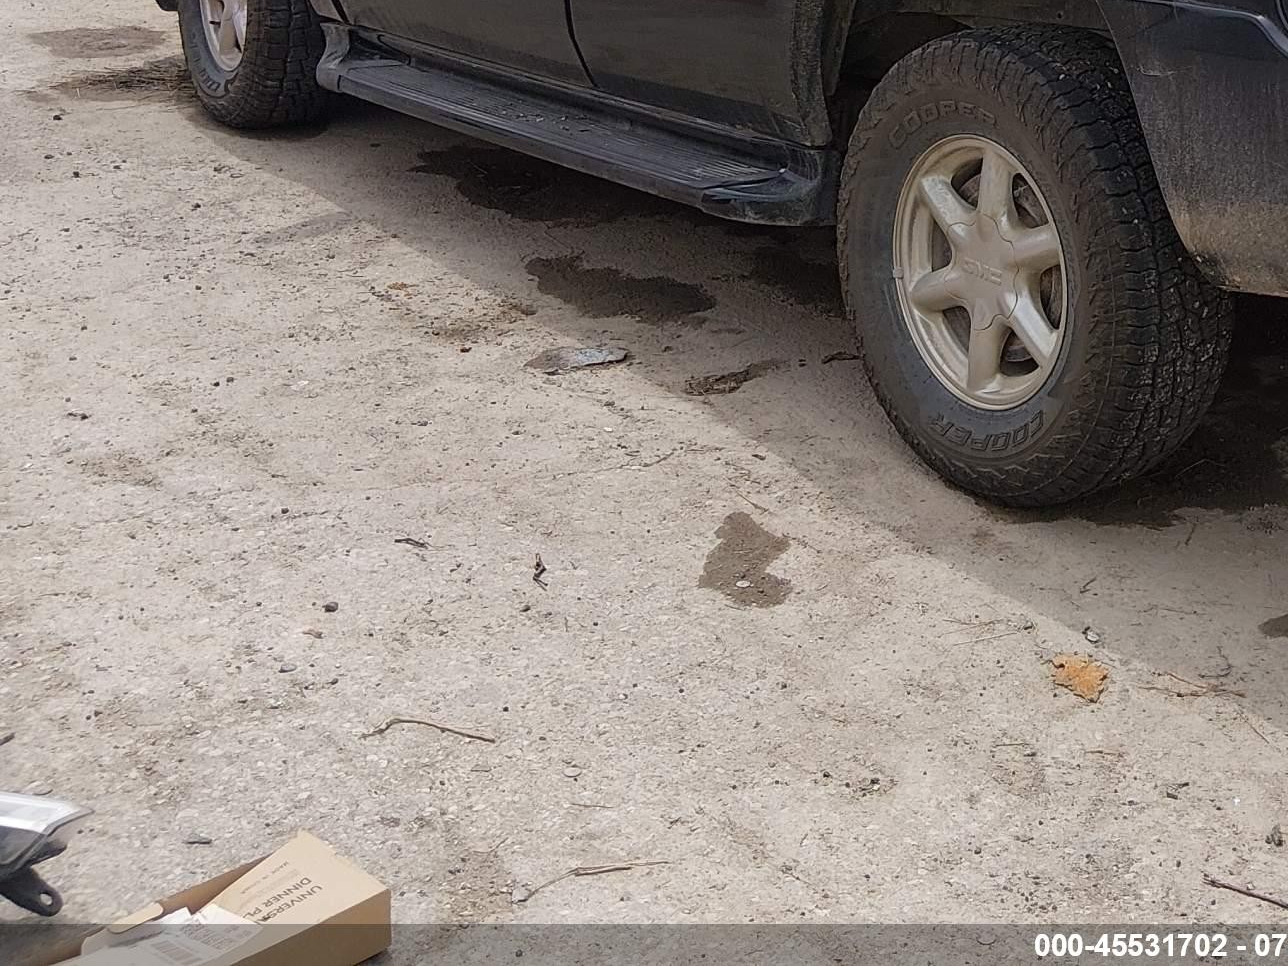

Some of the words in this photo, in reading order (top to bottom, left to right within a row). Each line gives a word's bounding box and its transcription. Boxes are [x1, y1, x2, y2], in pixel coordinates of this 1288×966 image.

[888, 100, 999, 149] COOPER
[928, 409, 1044, 452] COOPER
[264, 877, 313, 908] DINNER
